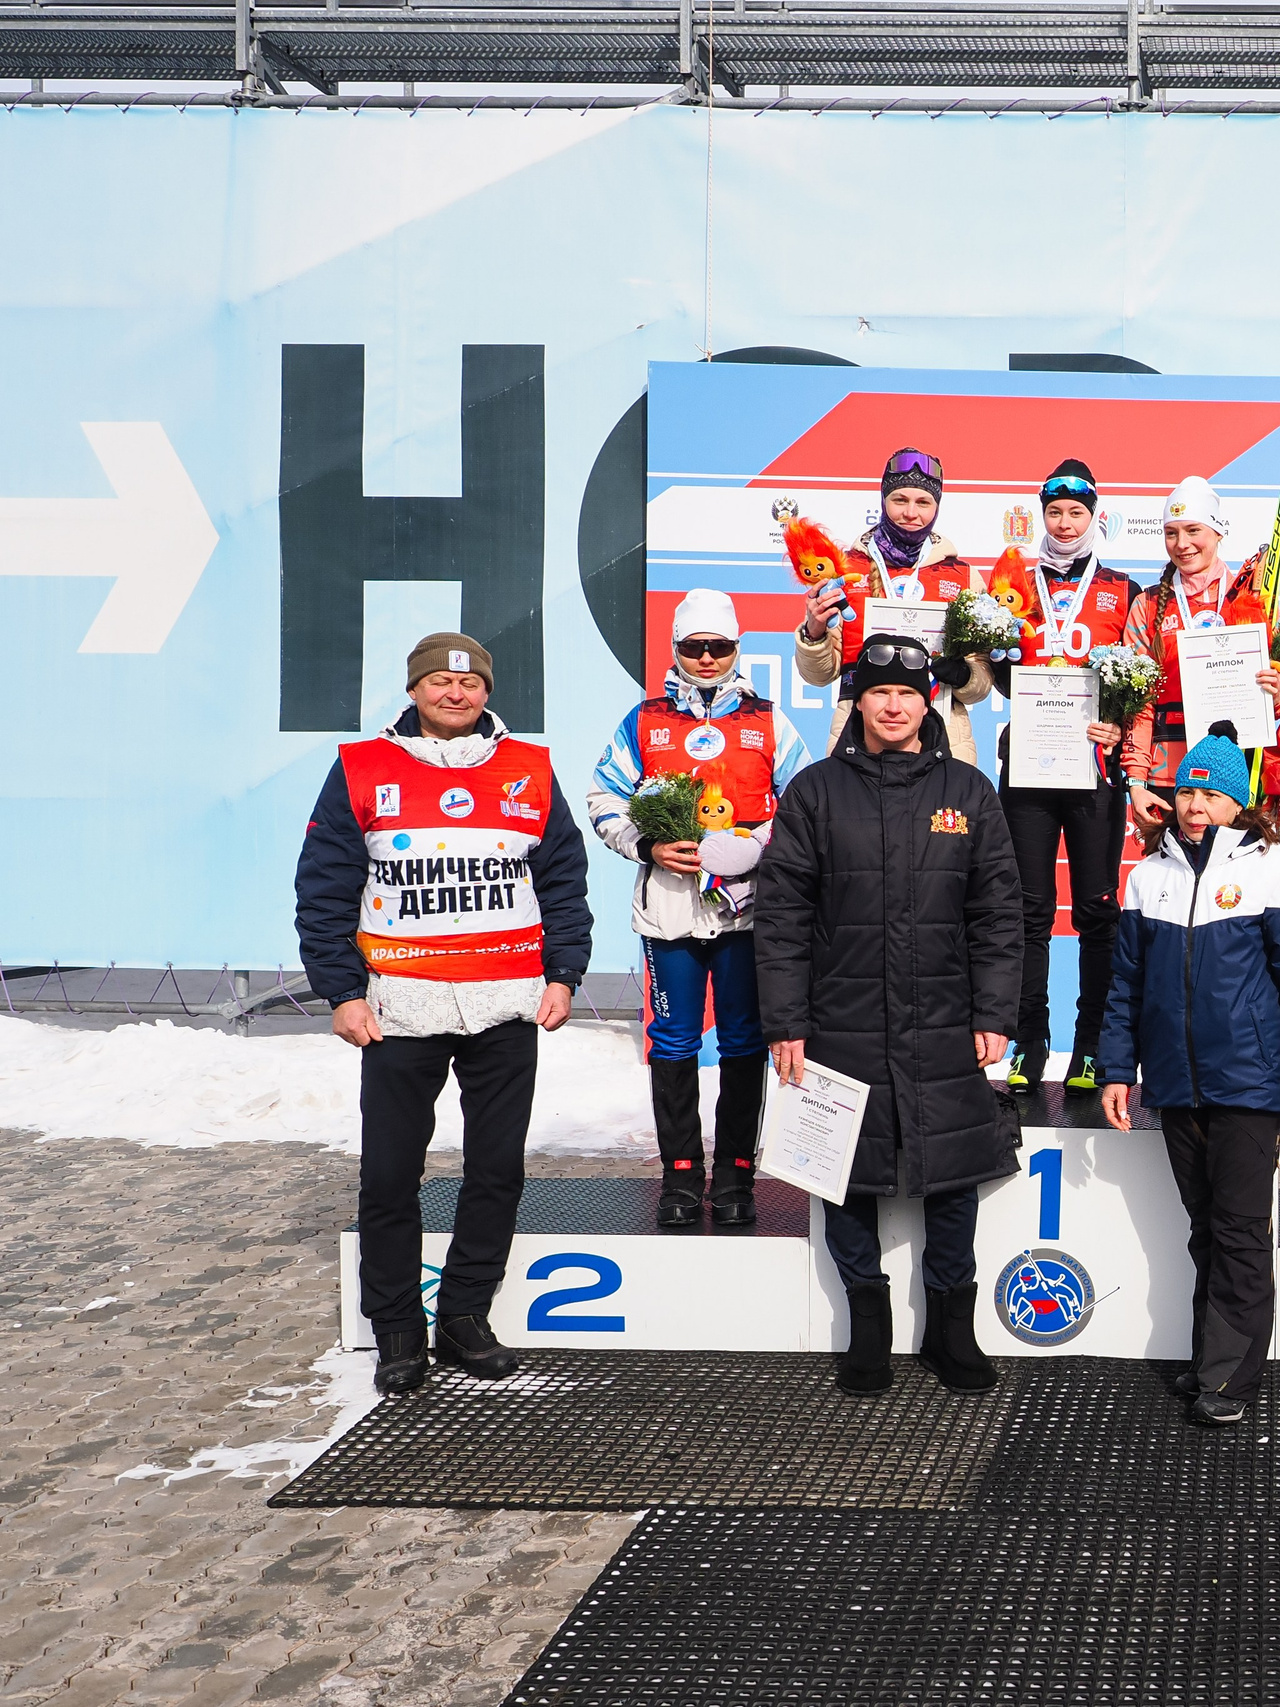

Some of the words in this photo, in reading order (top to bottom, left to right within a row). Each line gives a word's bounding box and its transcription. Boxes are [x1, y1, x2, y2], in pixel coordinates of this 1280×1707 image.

[1127, 518, 1164, 526] МИНИСТ
[1035, 622, 1091, 658] 10
[1205, 659, 1244, 669] ДИПЛОМ
[398, 883, 516, 920] ДЕЛЕГАТ
[645, 937, 662, 1017] АНКТ-ПЕТЕРБУРГ
[801, 1095, 838, 1116] ДИПЛОМ
[1029, 1148, 1062, 1241] 1
[525, 1252, 626, 1332] 2
[995, 1256, 1025, 1304] АКАДЕМИЯ
[1060, 1254, 1093, 1299] БИАТЛОНА
[1015, 1328, 1061, 1344] КРАСНОЯРСКИЙ
